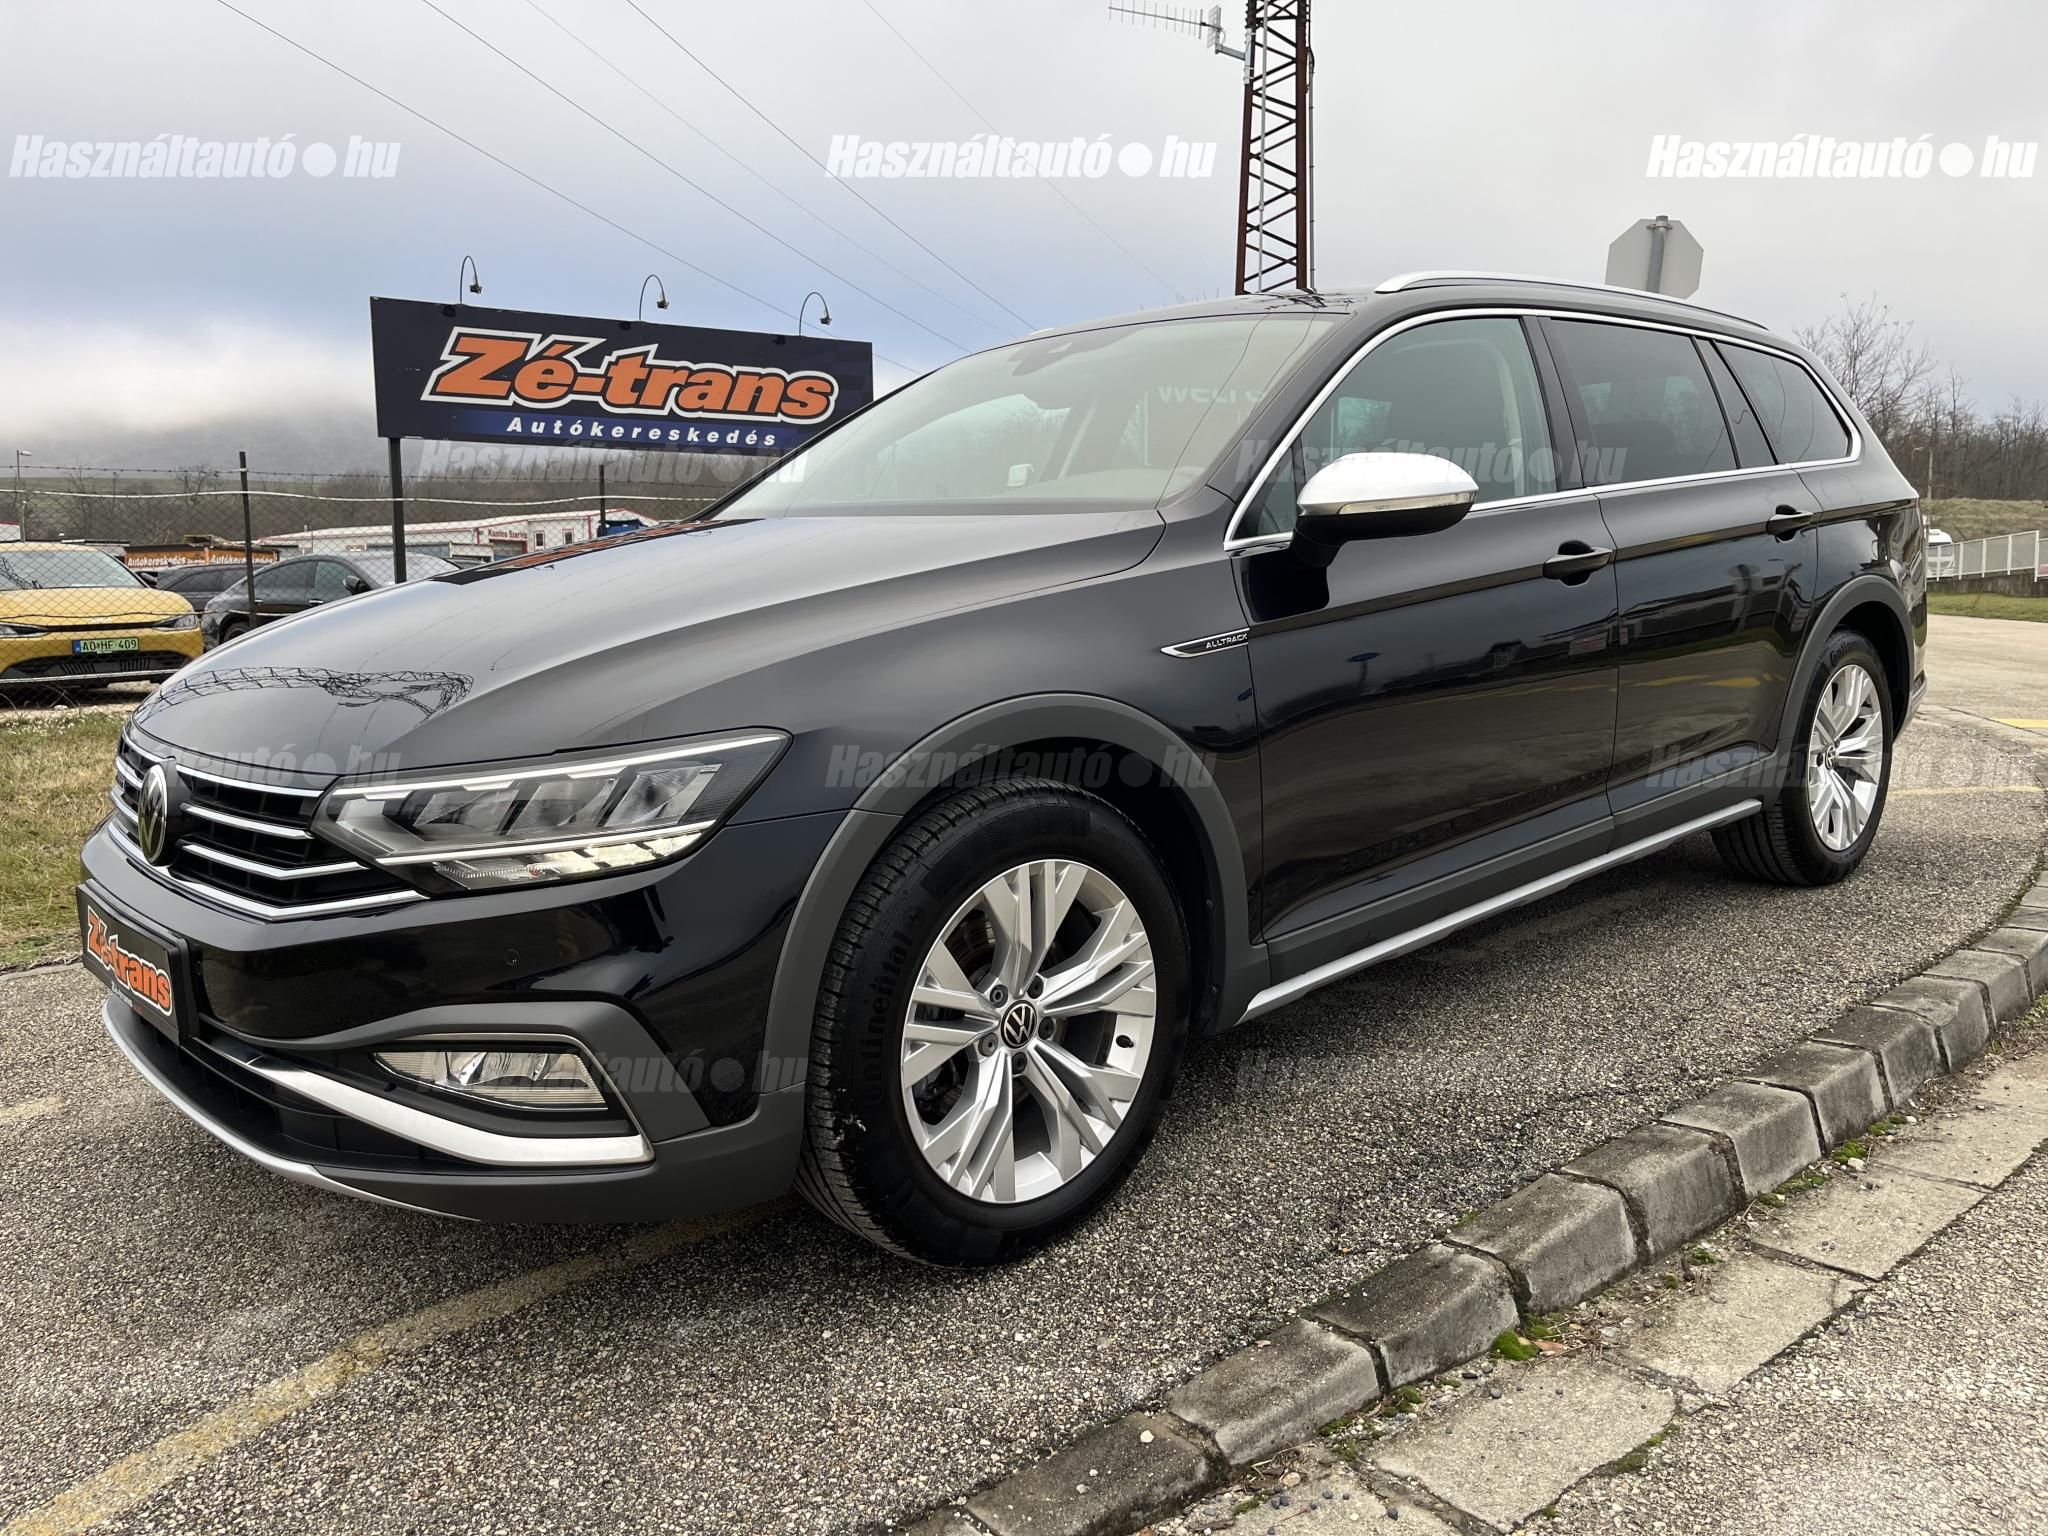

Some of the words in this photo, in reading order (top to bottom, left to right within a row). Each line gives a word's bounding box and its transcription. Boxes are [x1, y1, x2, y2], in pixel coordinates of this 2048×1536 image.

[424, 328, 839, 423] Zé-trans
[506, 416, 776, 447] Autókereskedés
[1206, 633, 1248, 649] ALLTRACK
